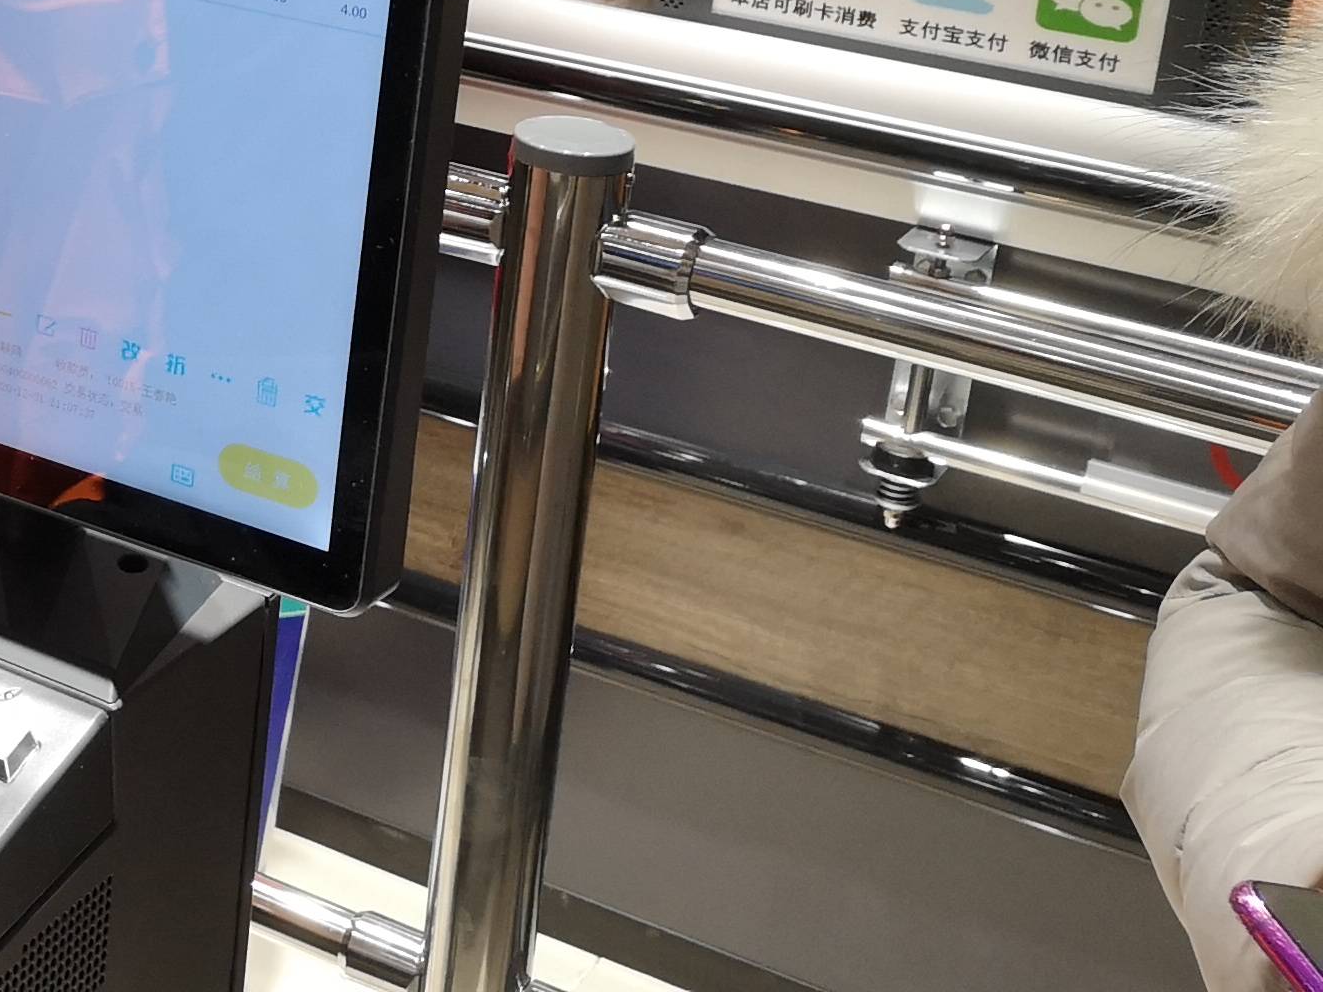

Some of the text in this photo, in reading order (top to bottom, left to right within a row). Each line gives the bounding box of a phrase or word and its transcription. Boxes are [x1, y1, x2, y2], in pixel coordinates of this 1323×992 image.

[340, 4, 368, 20] 4.00
[899, 18, 1008, 53] 支付宝支付
[1029, 39, 1120, 73] 微信支付
